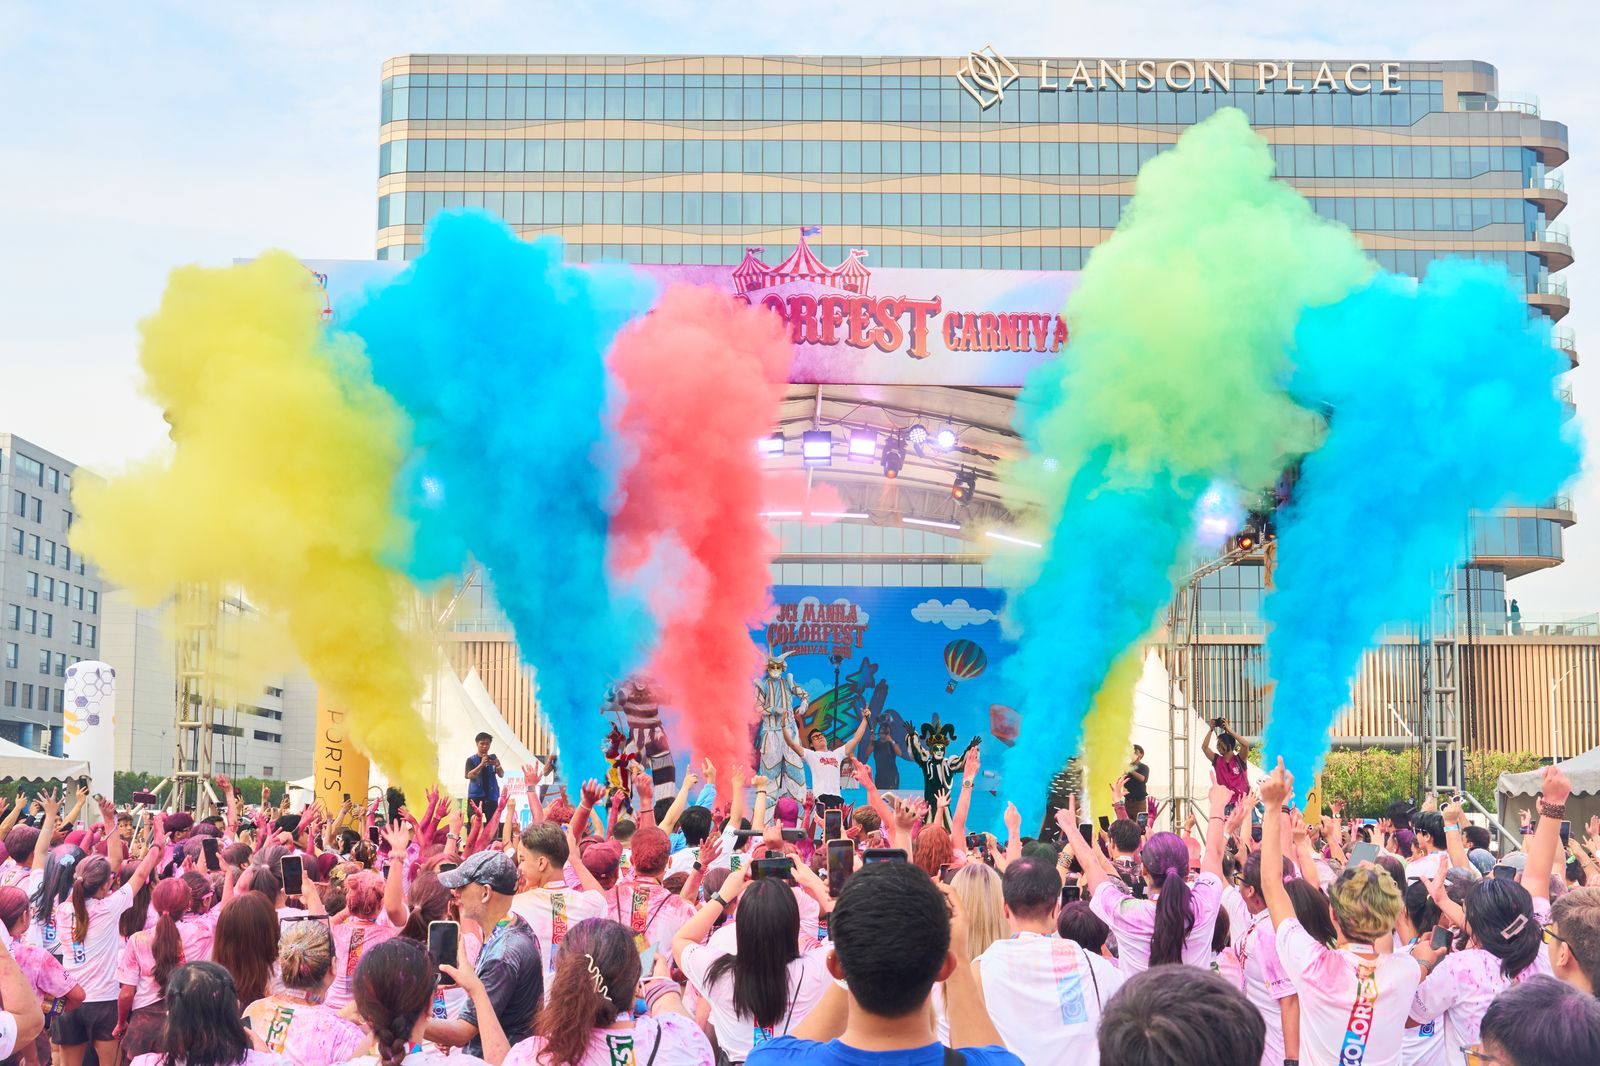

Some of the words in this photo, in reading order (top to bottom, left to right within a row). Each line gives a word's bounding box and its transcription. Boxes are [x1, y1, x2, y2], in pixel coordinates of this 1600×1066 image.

[1039, 59, 1231, 93] LANSON
[1257, 60, 1402, 94] PLACE
[777, 603, 798, 622] JCI
[802, 603, 858, 623] MANILA
[767, 623, 868, 648] COLORFEST
